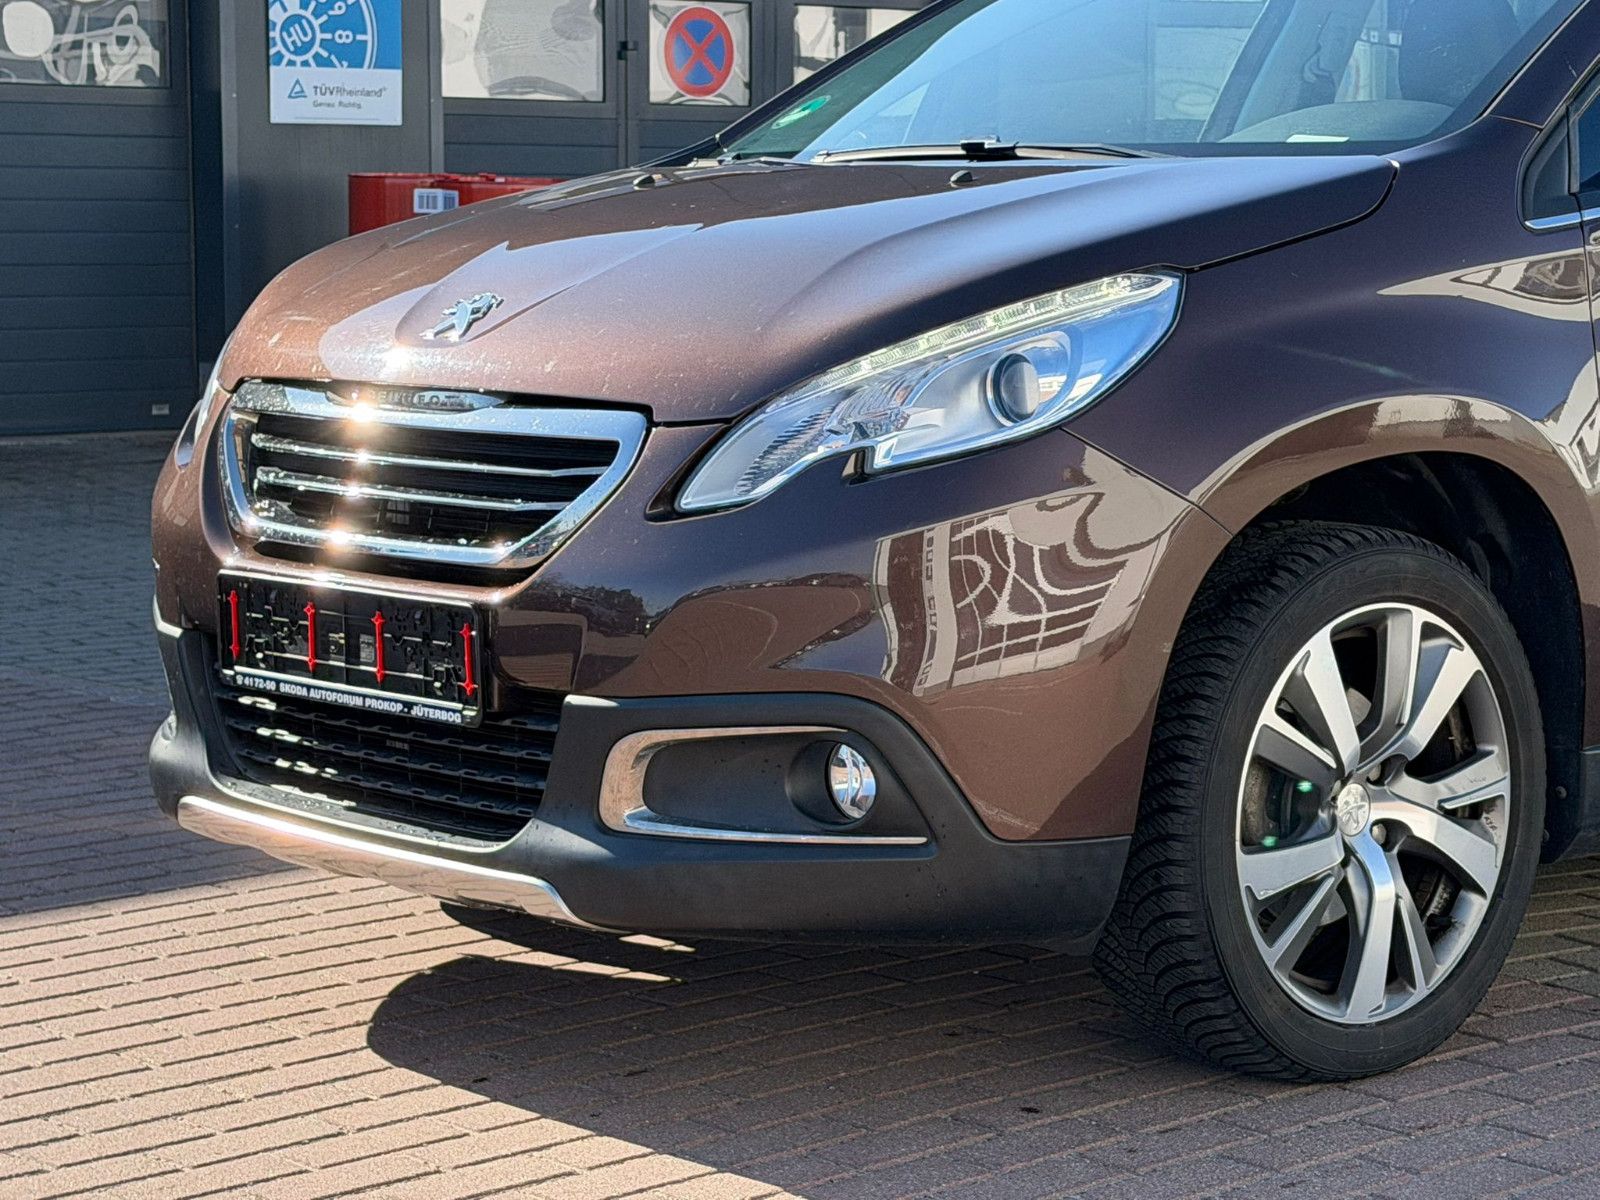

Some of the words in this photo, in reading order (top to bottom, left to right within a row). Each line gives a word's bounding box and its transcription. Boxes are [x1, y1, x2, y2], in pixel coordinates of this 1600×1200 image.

[282, 18, 312, 52] HU
[334, 29, 353, 44] 8
[279, 682, 308, 697] SKODA
[309, 688, 364, 706] AUTOFORUM
[365, 697, 403, 713] PROKOP
